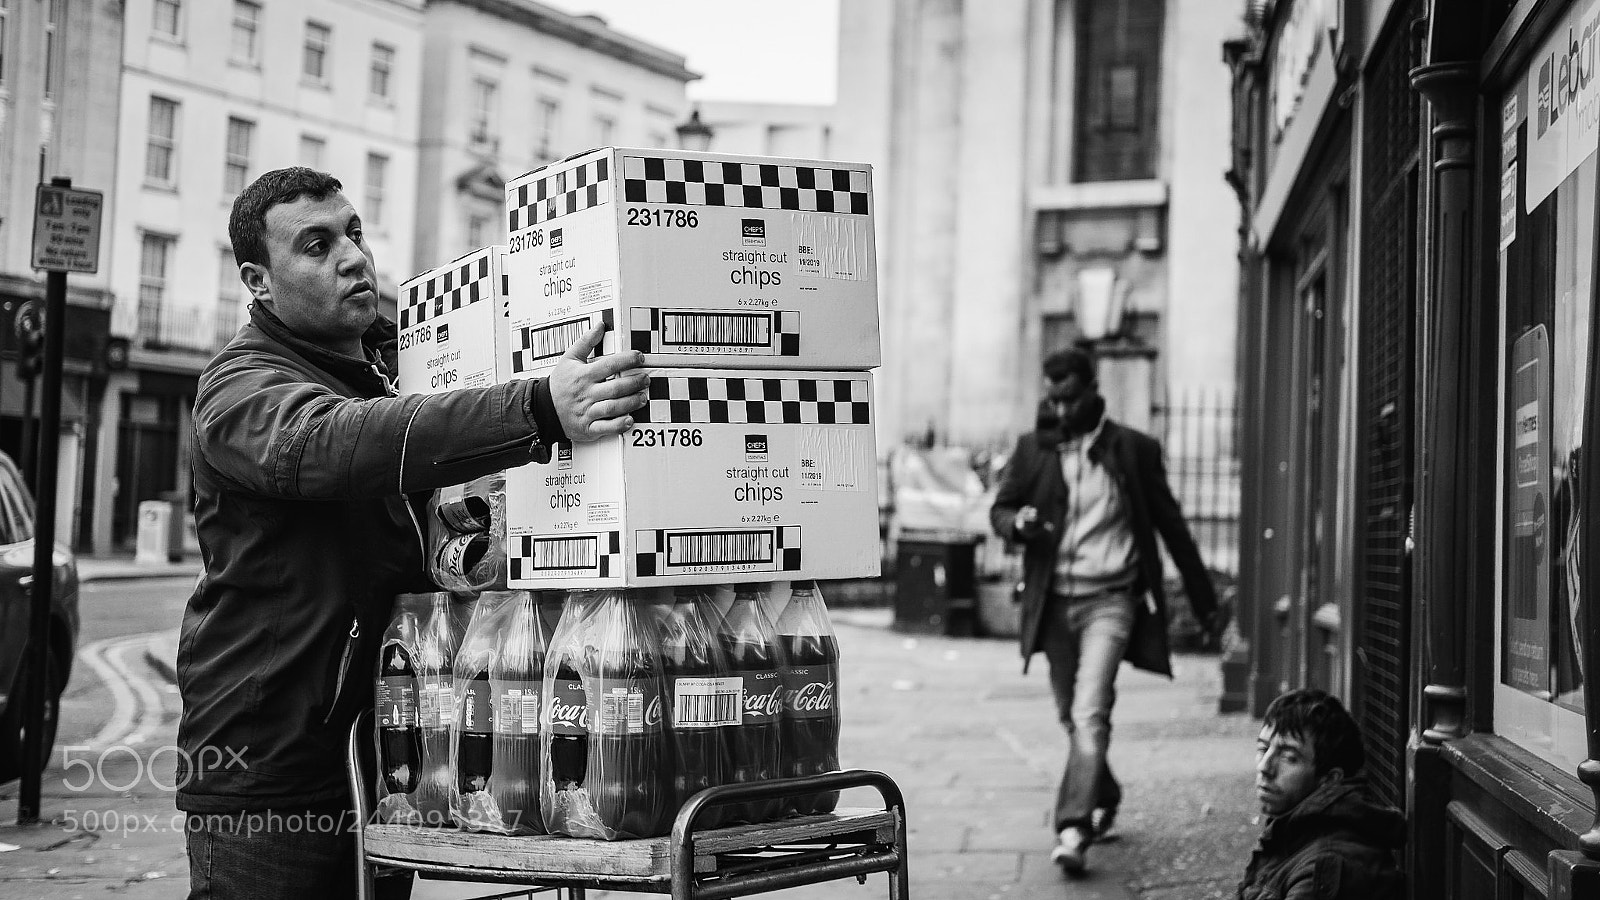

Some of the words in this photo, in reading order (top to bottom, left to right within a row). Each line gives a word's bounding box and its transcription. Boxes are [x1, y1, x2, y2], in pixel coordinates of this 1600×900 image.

[627, 207, 699, 228] 231786
[509, 228, 544, 254] 231786
[539, 258, 564, 276] straight
[565, 257, 576, 269] cut
[722, 250, 767, 264] straight
[769, 252, 788, 263] cut
[543, 275, 573, 298] chips
[731, 266, 781, 290] chips
[737, 298, 743, 306] 6
[748, 298, 769, 307] 2.27kg
[400, 325, 432, 351] 231786
[427, 353, 450, 370] straight
[450, 350, 461, 362] cut
[431, 368, 458, 389] chips
[632, 428, 703, 447] 231786
[545, 473, 572, 488] straight
[573, 473, 586, 484] cut
[726, 466, 769, 481] straight
[772, 466, 789, 478] cut
[550, 489, 581, 512] chips
[734, 482, 783, 506] chips
[741, 515, 746, 523] 6
[751, 515, 772, 524] 2.27kg
